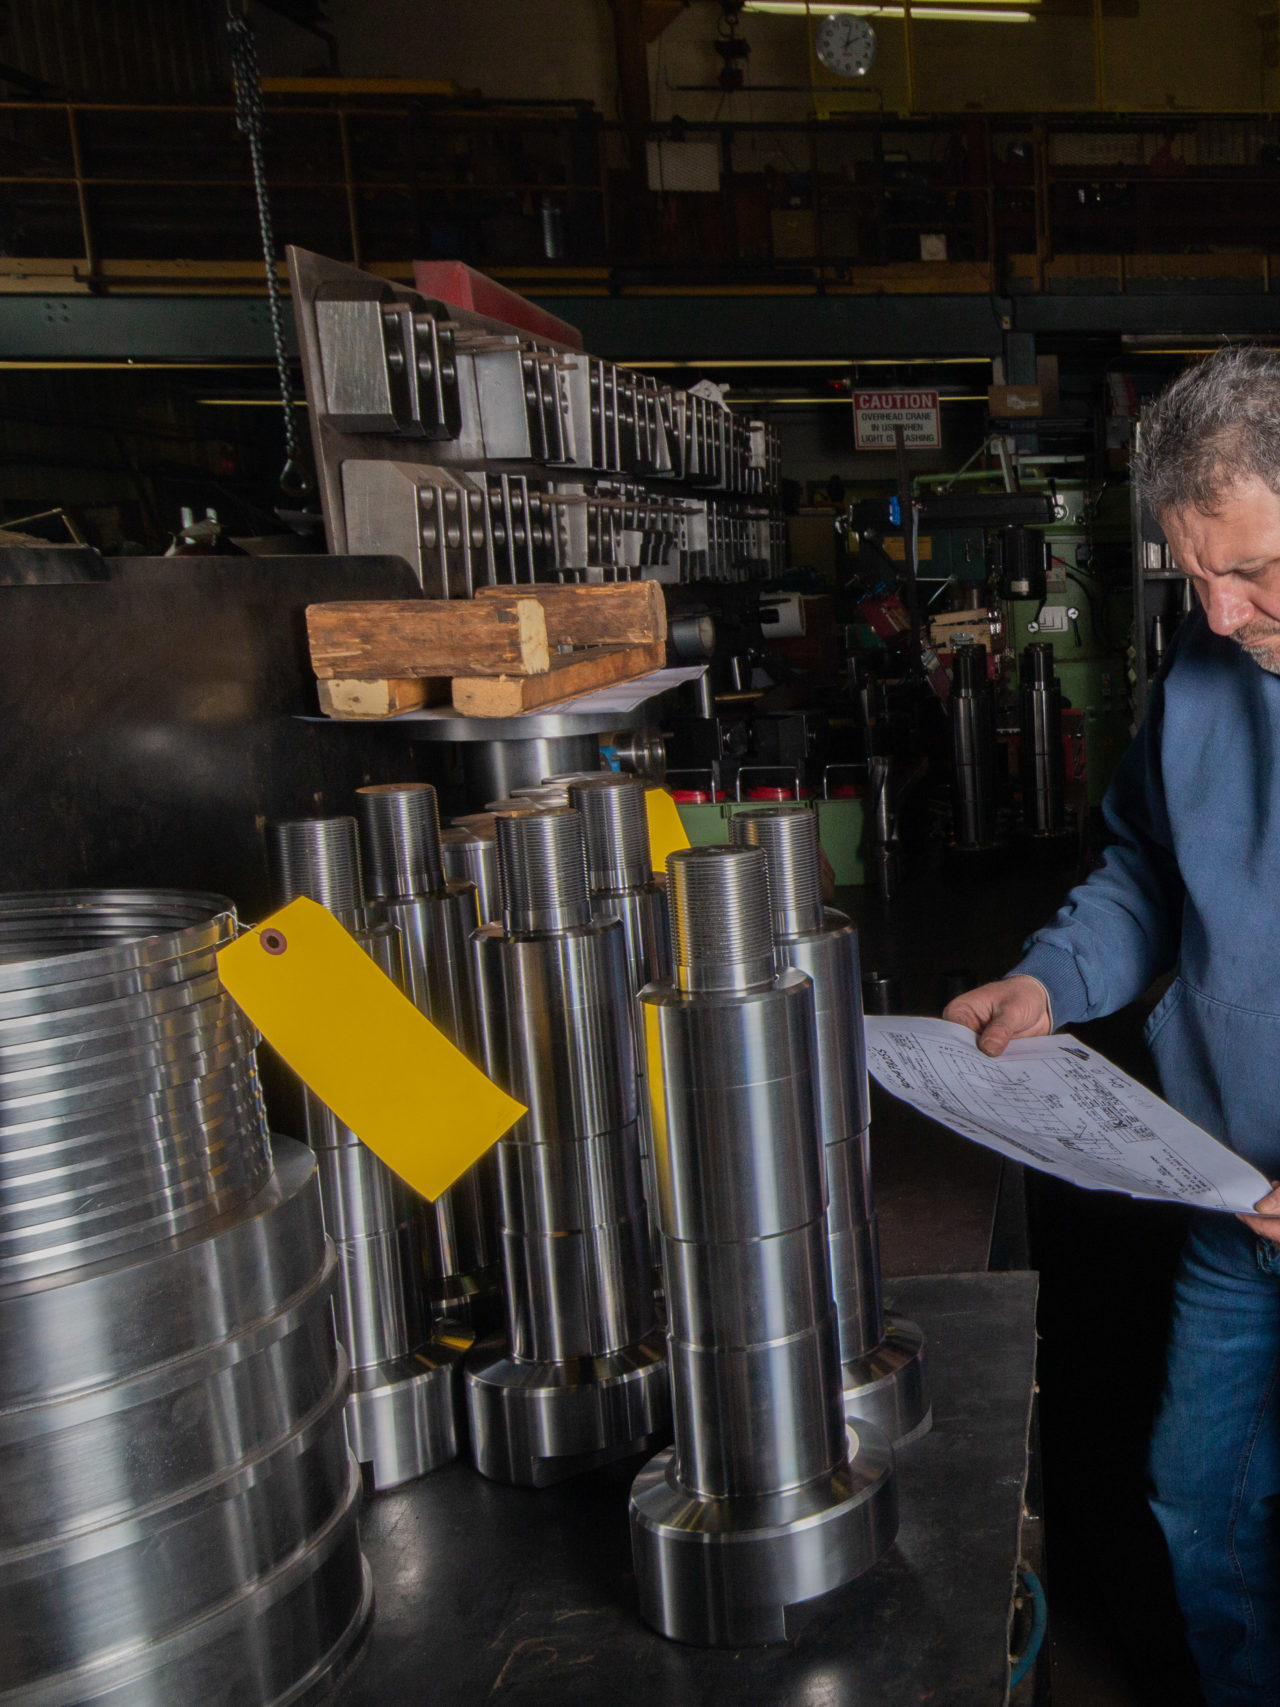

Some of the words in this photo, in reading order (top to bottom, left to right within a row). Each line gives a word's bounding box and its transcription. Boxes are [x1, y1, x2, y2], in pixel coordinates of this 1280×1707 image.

[859, 394, 933, 409] CAUTION
[861, 412, 903, 421] OVERHEAD
[905, 412, 932, 420] CRANE
[871, 423, 879, 431] IN
[861, 434, 884, 443] LIGHT
[886, 434, 894, 442] IS
[902, 433, 934, 442] ASHING
